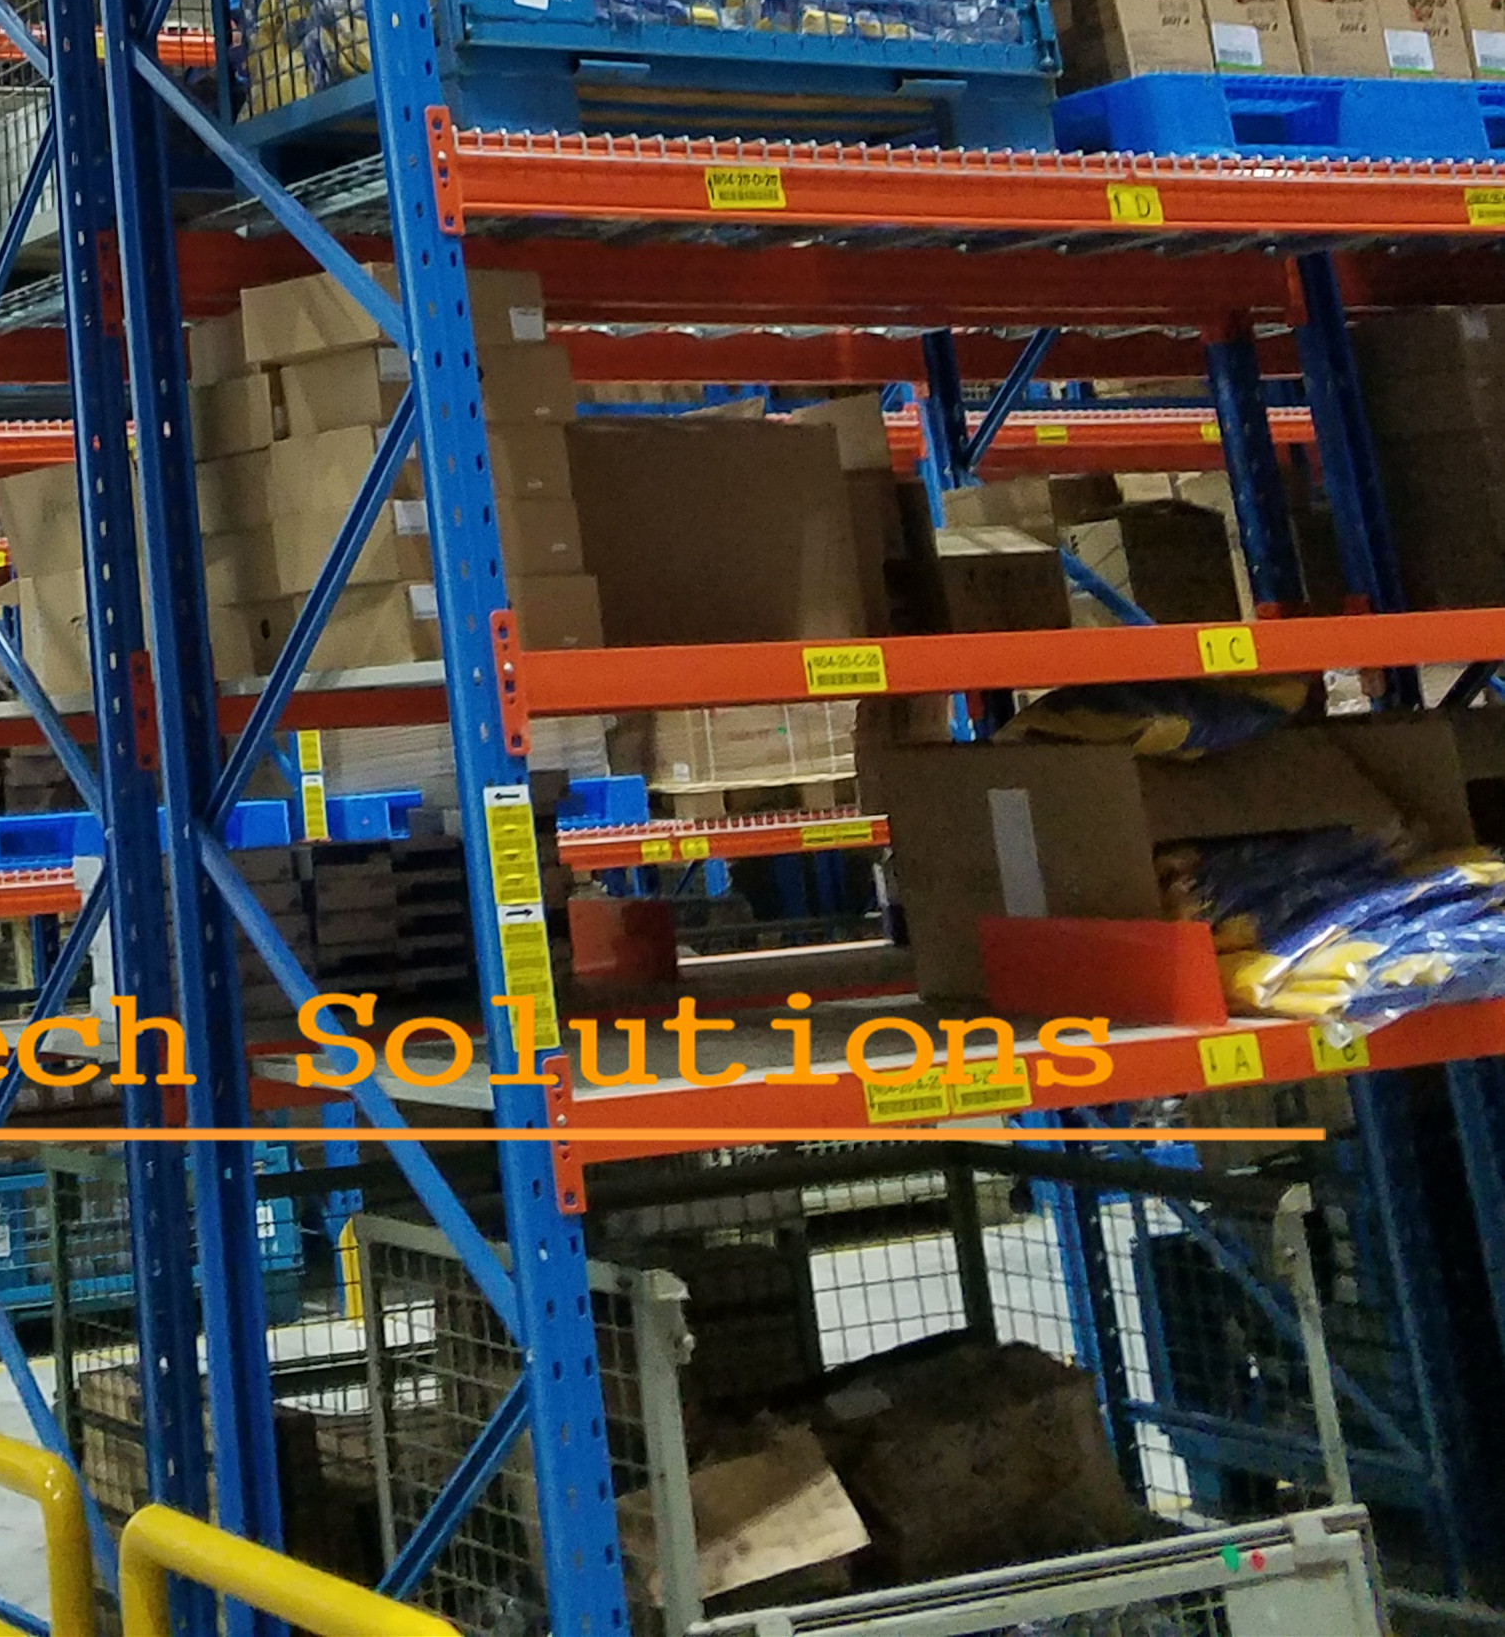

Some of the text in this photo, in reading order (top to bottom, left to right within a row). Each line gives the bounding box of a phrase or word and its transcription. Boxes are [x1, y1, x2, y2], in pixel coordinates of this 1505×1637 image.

[1134, 193, 1151, 219] D
[1228, 637, 1246, 665] C
[1234, 1045, 1252, 1074] A
